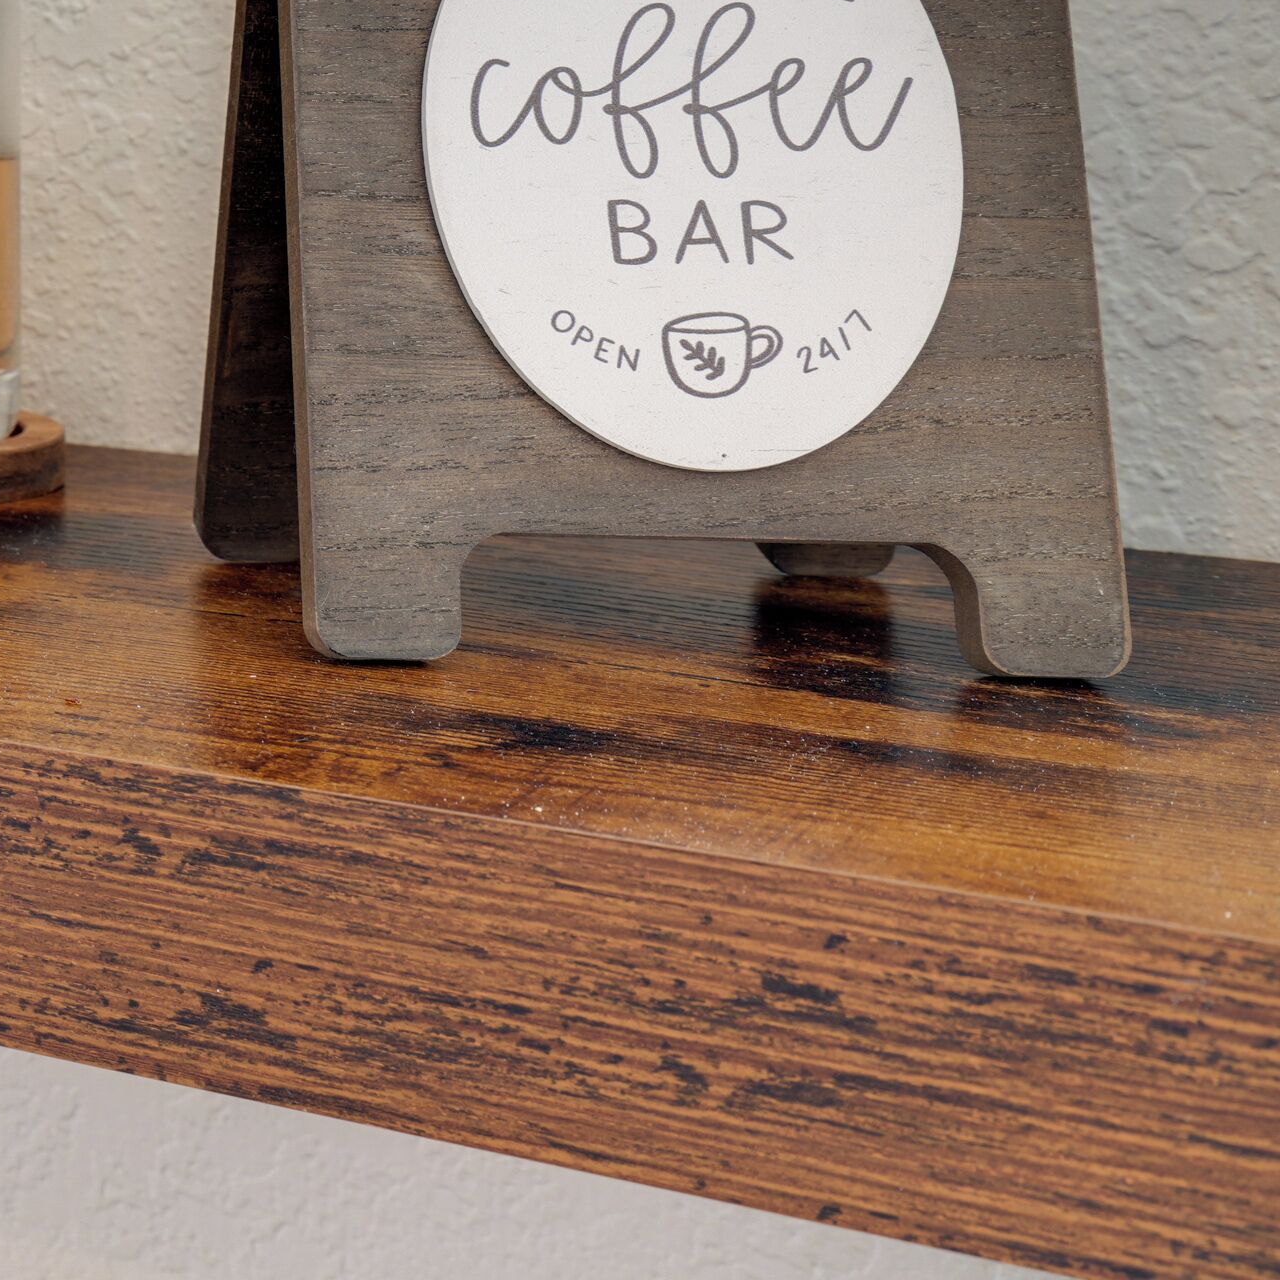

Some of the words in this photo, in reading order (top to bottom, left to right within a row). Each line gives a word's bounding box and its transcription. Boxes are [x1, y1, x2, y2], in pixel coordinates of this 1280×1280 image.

[470, 1, 914, 179] coffee
[606, 199, 794, 265] BAR
[551, 310, 640, 371] OPEN
